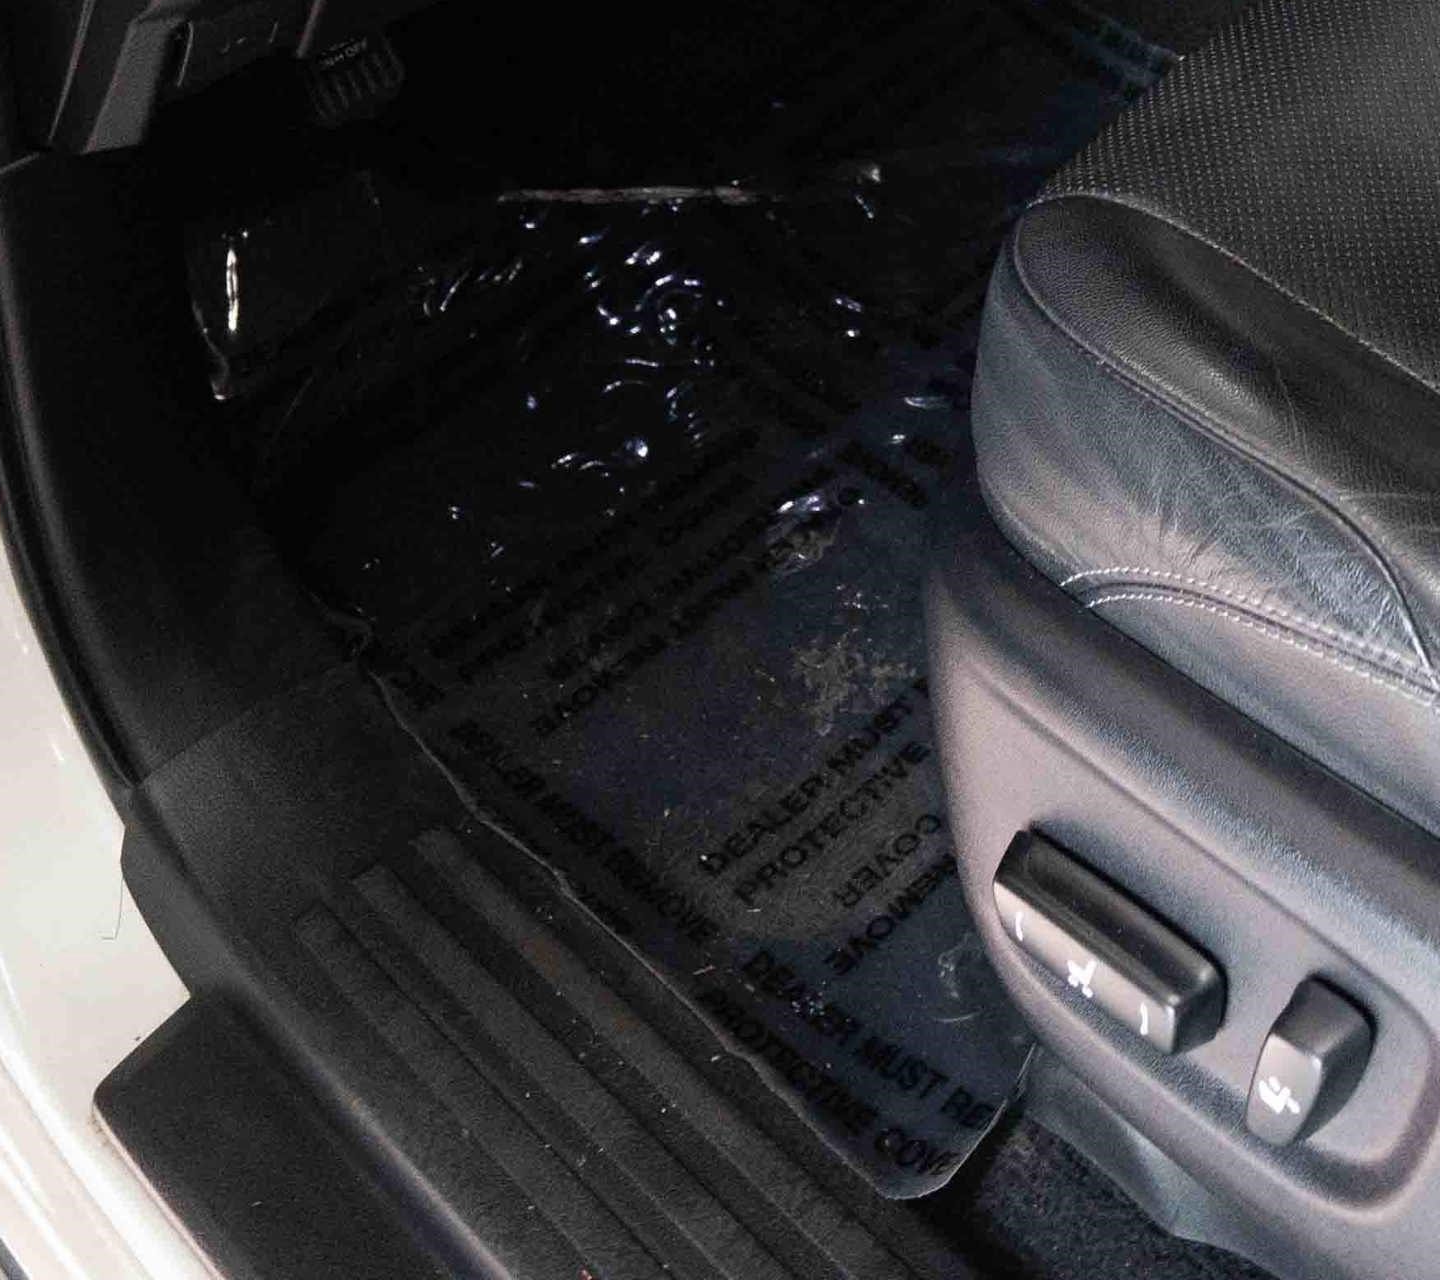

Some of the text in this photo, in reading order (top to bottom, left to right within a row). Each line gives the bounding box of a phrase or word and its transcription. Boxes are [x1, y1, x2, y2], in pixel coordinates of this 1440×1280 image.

[698, 773, 824, 876] DEALER
[826, 698, 913, 777] MUST
[734, 741, 932, 905] PROTECTIVE
[824, 853, 957, 977] REMOVE
[832, 813, 942, 908] COVER
[854, 1036, 948, 1100] MUST
